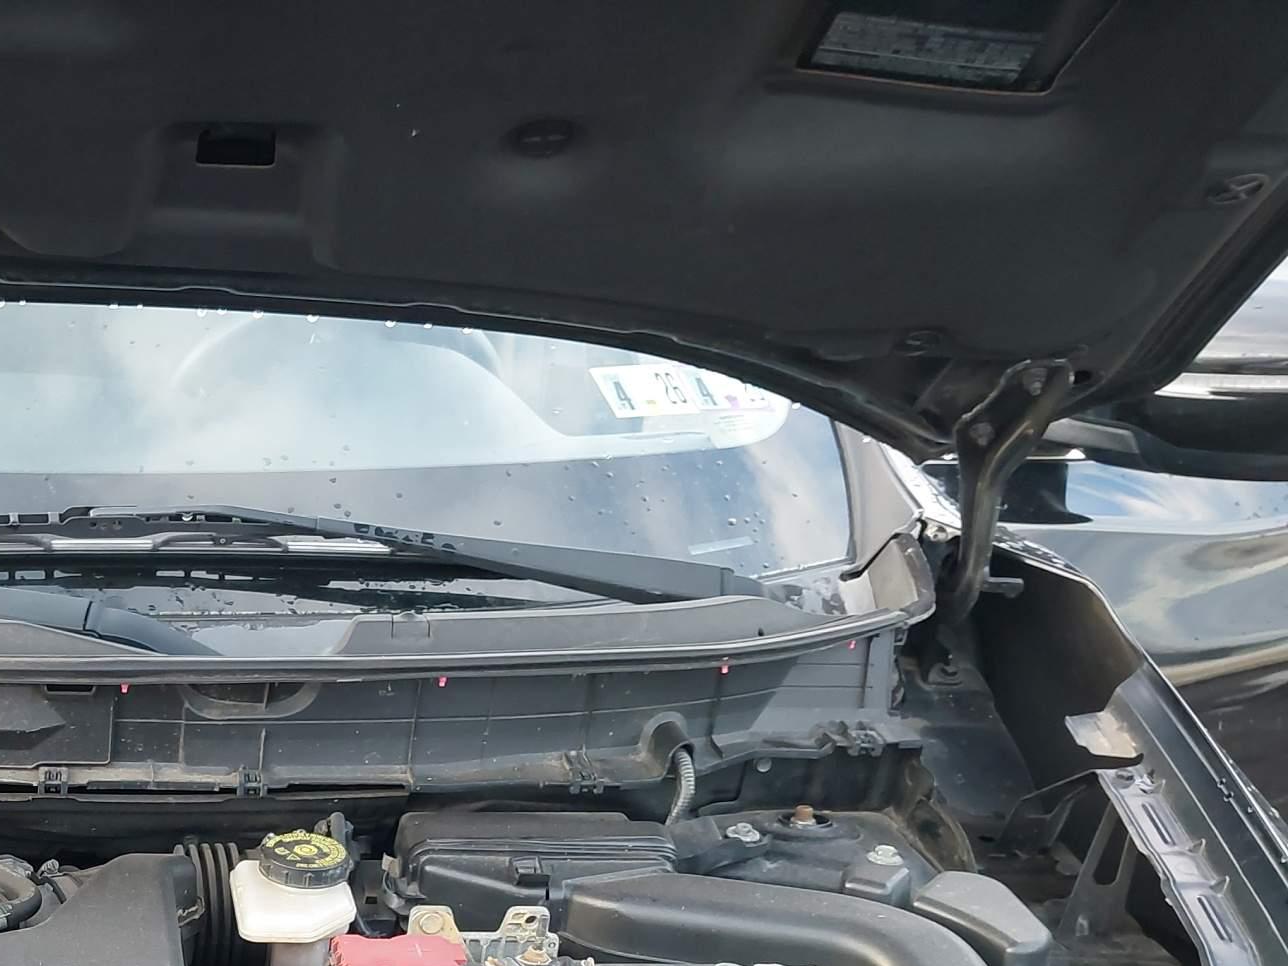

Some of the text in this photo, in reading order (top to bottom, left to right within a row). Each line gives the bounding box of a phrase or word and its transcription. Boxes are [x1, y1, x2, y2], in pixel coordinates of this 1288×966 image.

[613, 381, 636, 410] 4
[654, 372, 688, 405] 26
[695, 377, 718, 406] 4
